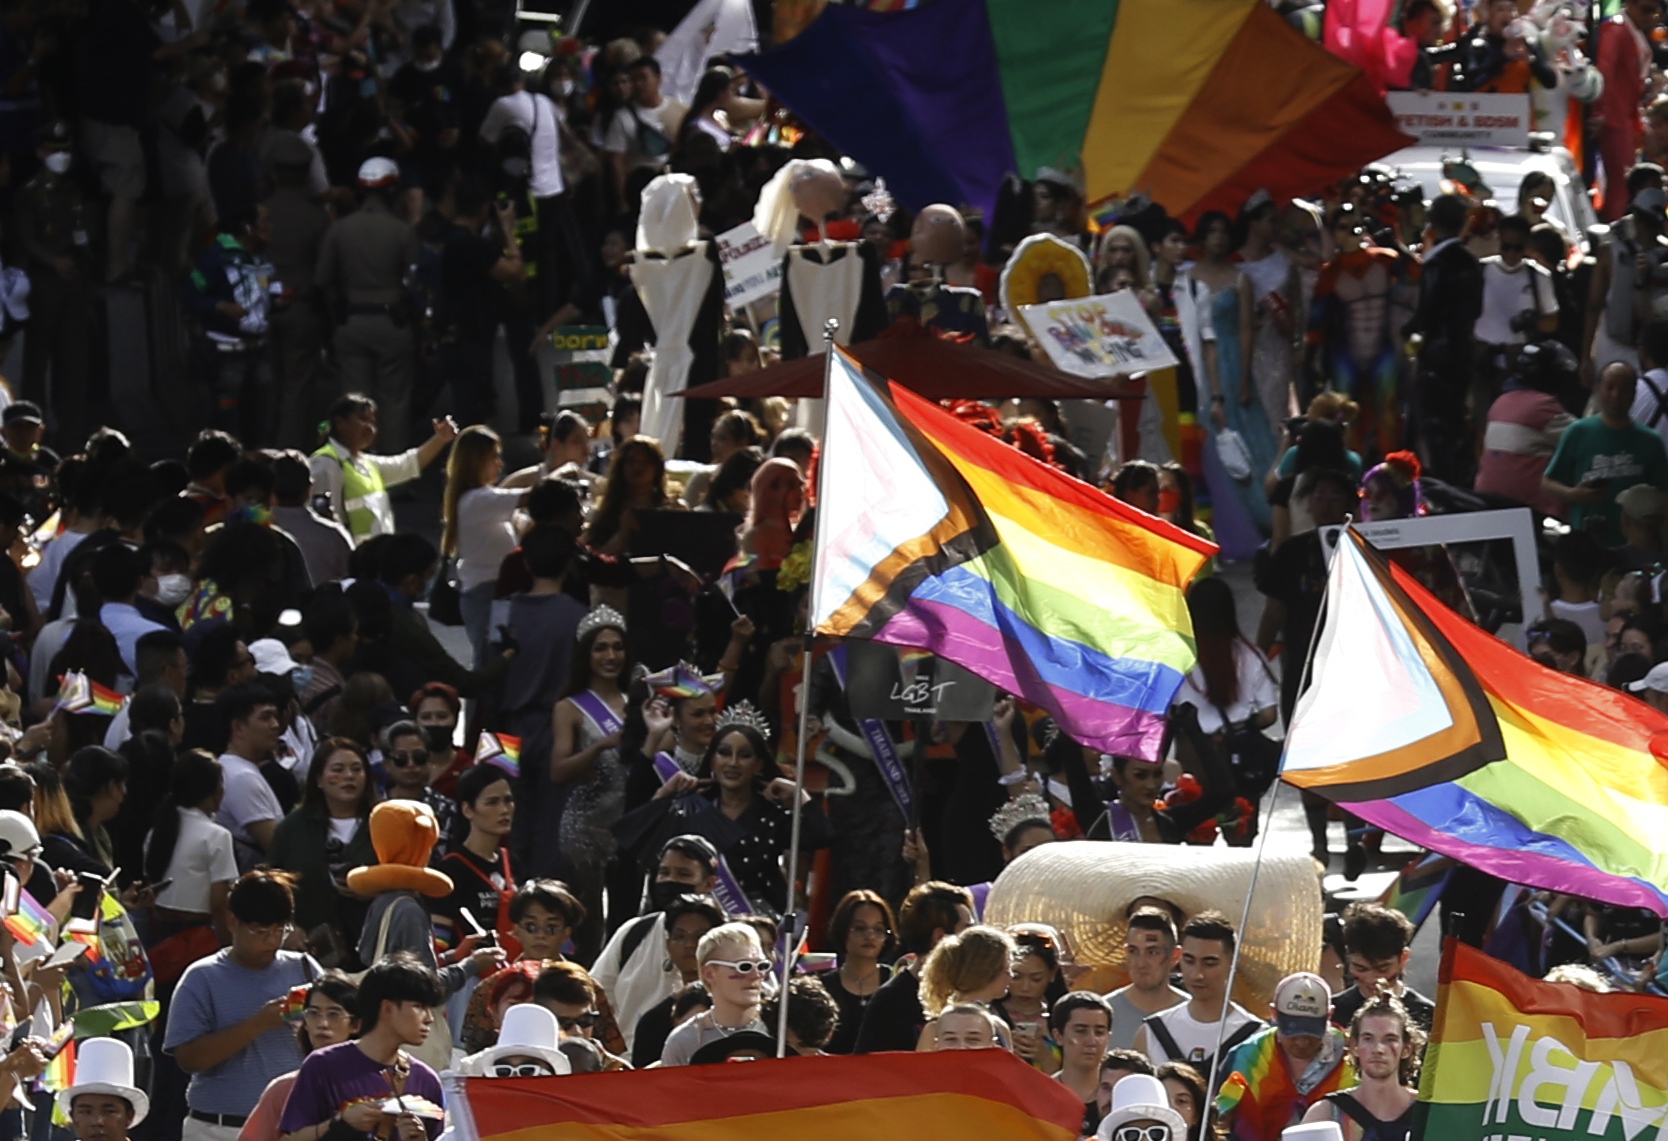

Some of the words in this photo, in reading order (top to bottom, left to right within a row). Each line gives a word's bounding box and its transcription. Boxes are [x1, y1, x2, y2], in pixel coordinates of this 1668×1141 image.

[1397, 115, 1453, 128] FETISH
[1456, 115, 1469, 128] &
[1474, 115, 1519, 129] BDSM
[890, 681, 957, 704] LGBT
[870, 728, 902, 785] THAILAND
